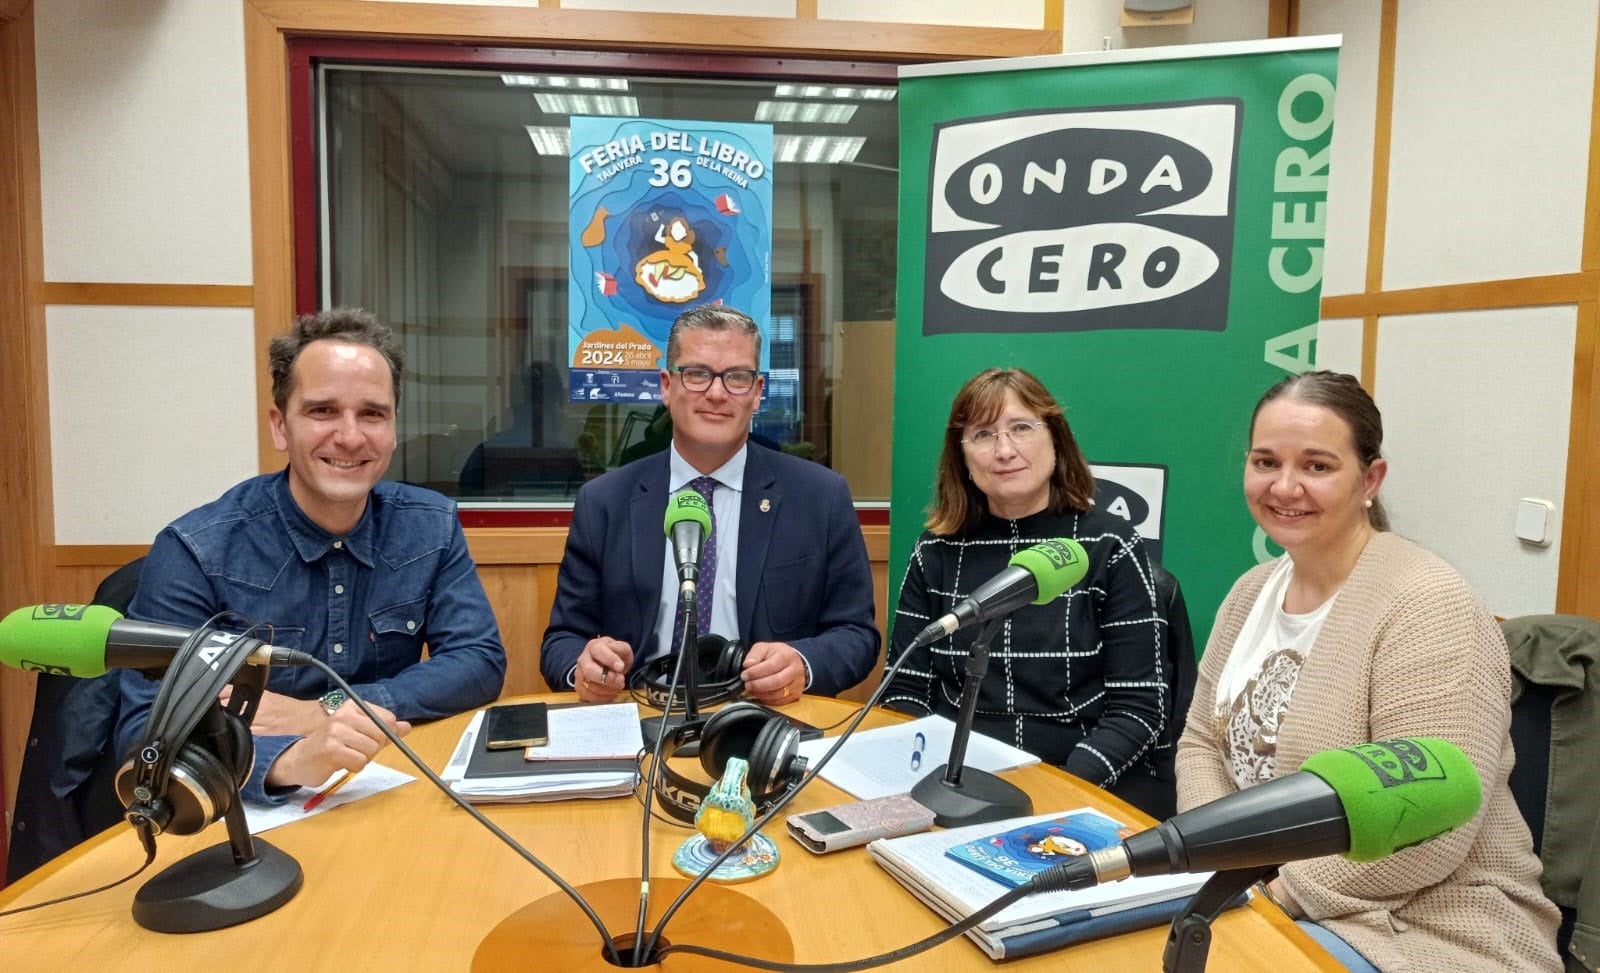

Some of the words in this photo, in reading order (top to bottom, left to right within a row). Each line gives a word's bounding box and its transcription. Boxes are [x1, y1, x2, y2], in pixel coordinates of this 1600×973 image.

[578, 134, 647, 175] FERIA
[651, 131, 694, 152] DEL
[698, 136, 765, 180] LIBRO
[596, 155, 643, 182] TALAVERA
[649, 157, 693, 189] 36
[696, 156, 710, 168] DE
[709, 161, 721, 173] LA
[721, 165, 749, 190] REINA
[969, 154, 1183, 205] ONDA
[1268, 73, 1336, 294] CERO
[976, 242, 1181, 295] CERO
[582, 350, 625, 365] 2024
[583, 341, 615, 350] Jardines
[615, 342, 628, 351] del
[628, 343, 653, 351] Prado
[635, 352, 652, 360] abril
[197, 631, 241, 671] AK
